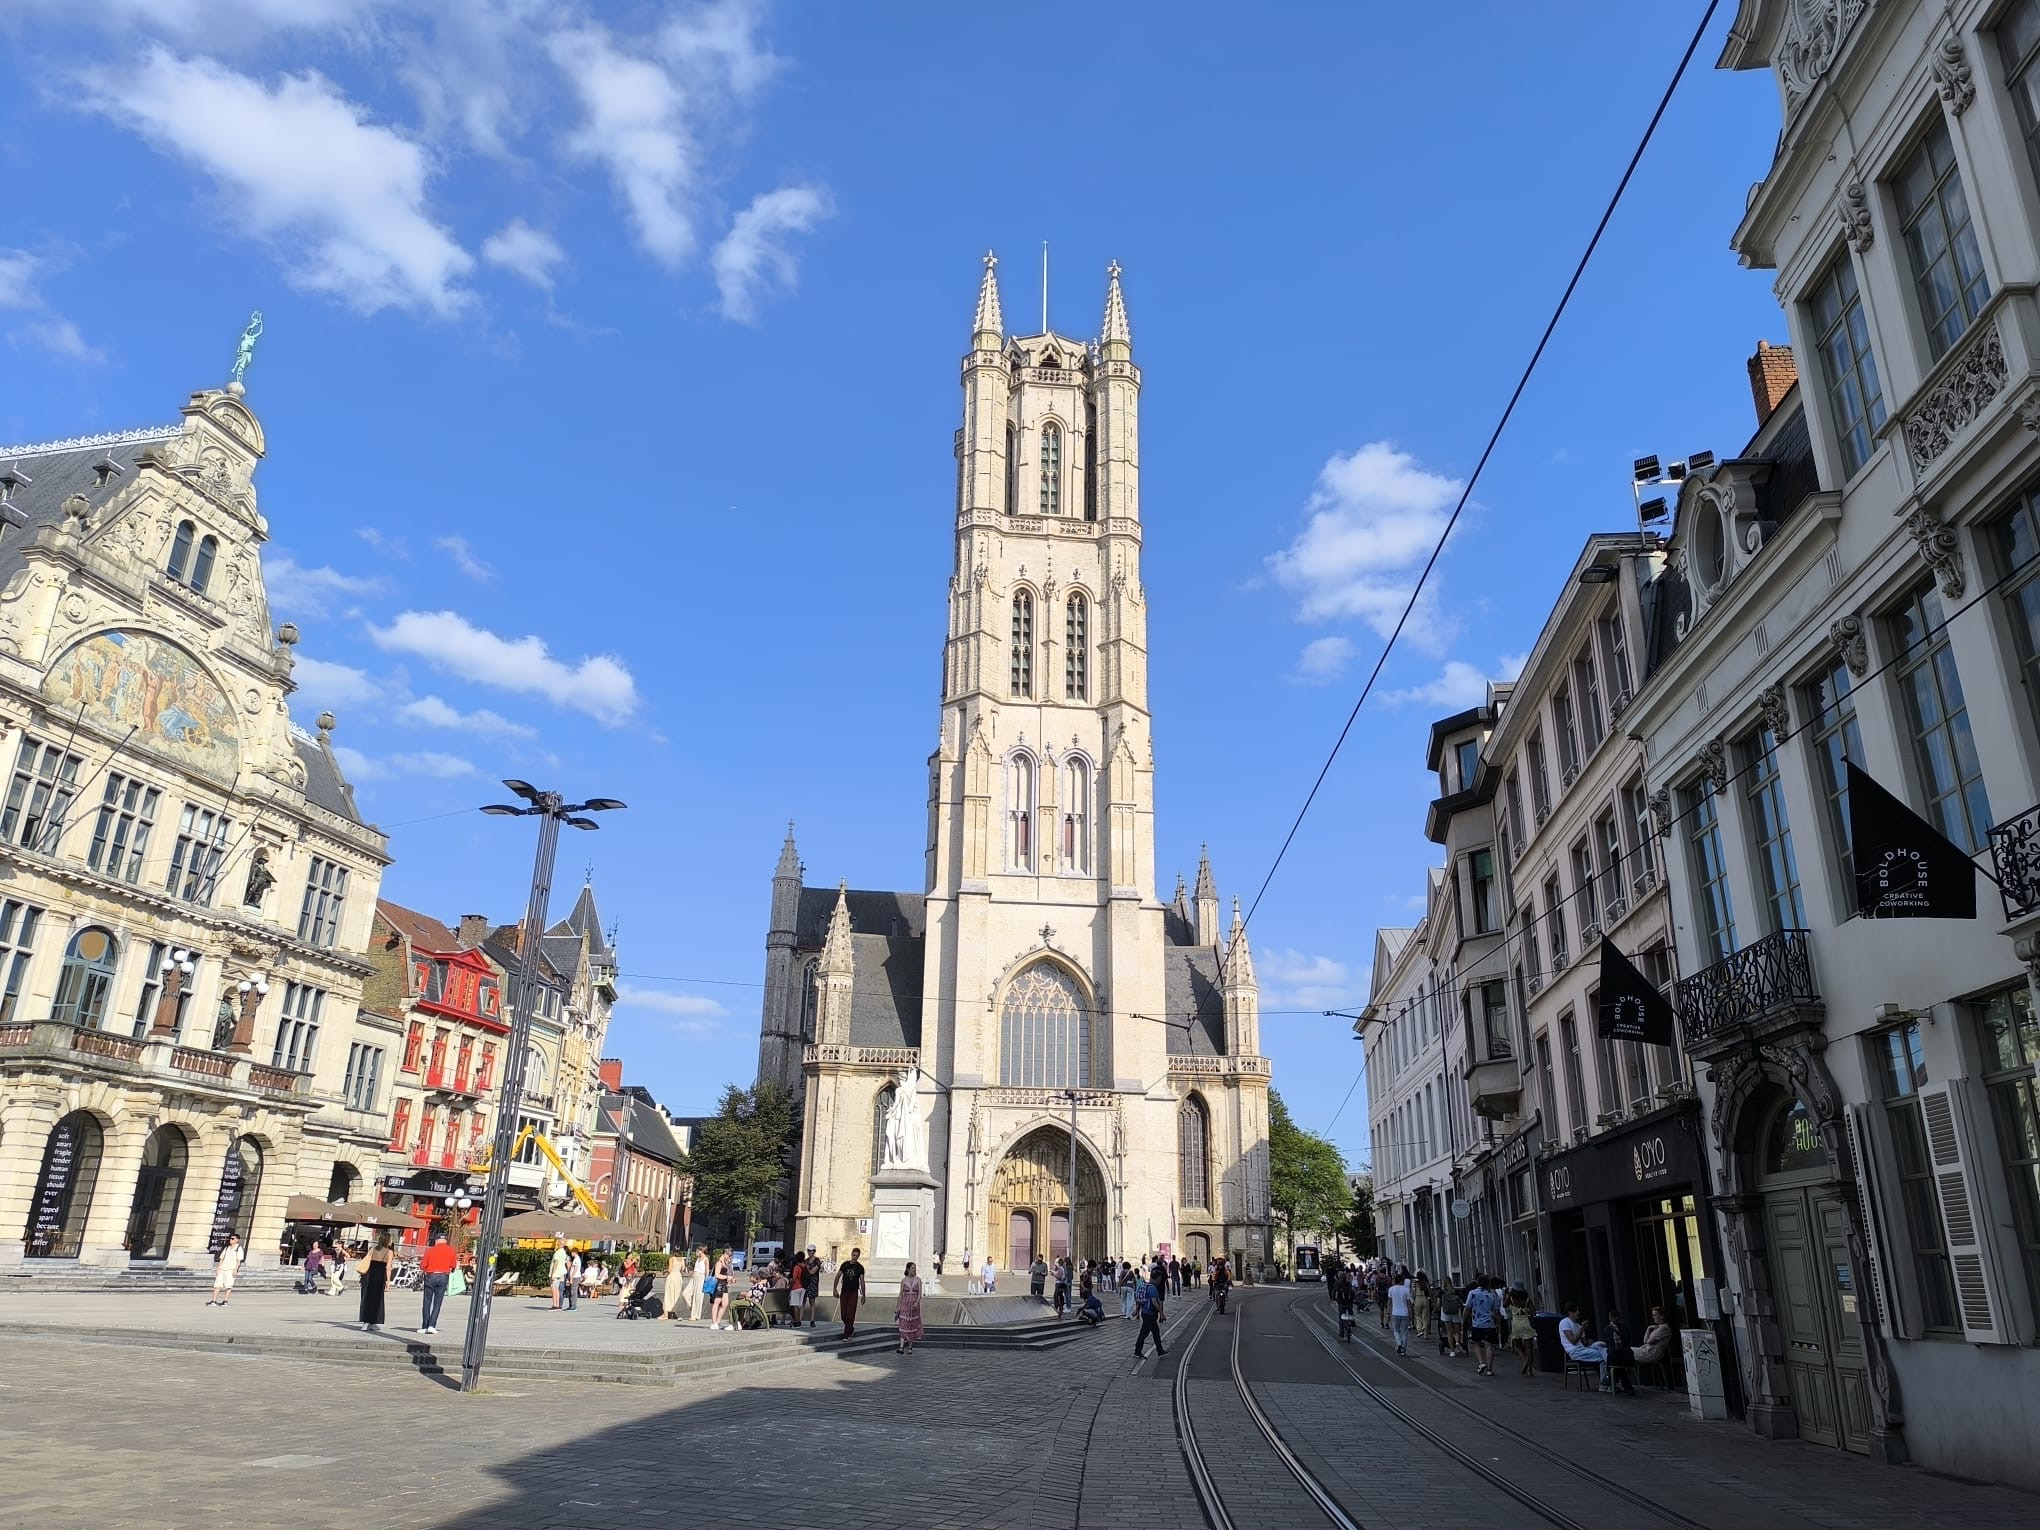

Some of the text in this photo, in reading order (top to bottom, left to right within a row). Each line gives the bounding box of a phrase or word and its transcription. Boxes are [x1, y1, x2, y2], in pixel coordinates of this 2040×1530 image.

[1613, 1028, 1645, 1036] COWORKING
[54, 1149, 72, 1157] fragile
[36, 1222, 60, 1230] because
